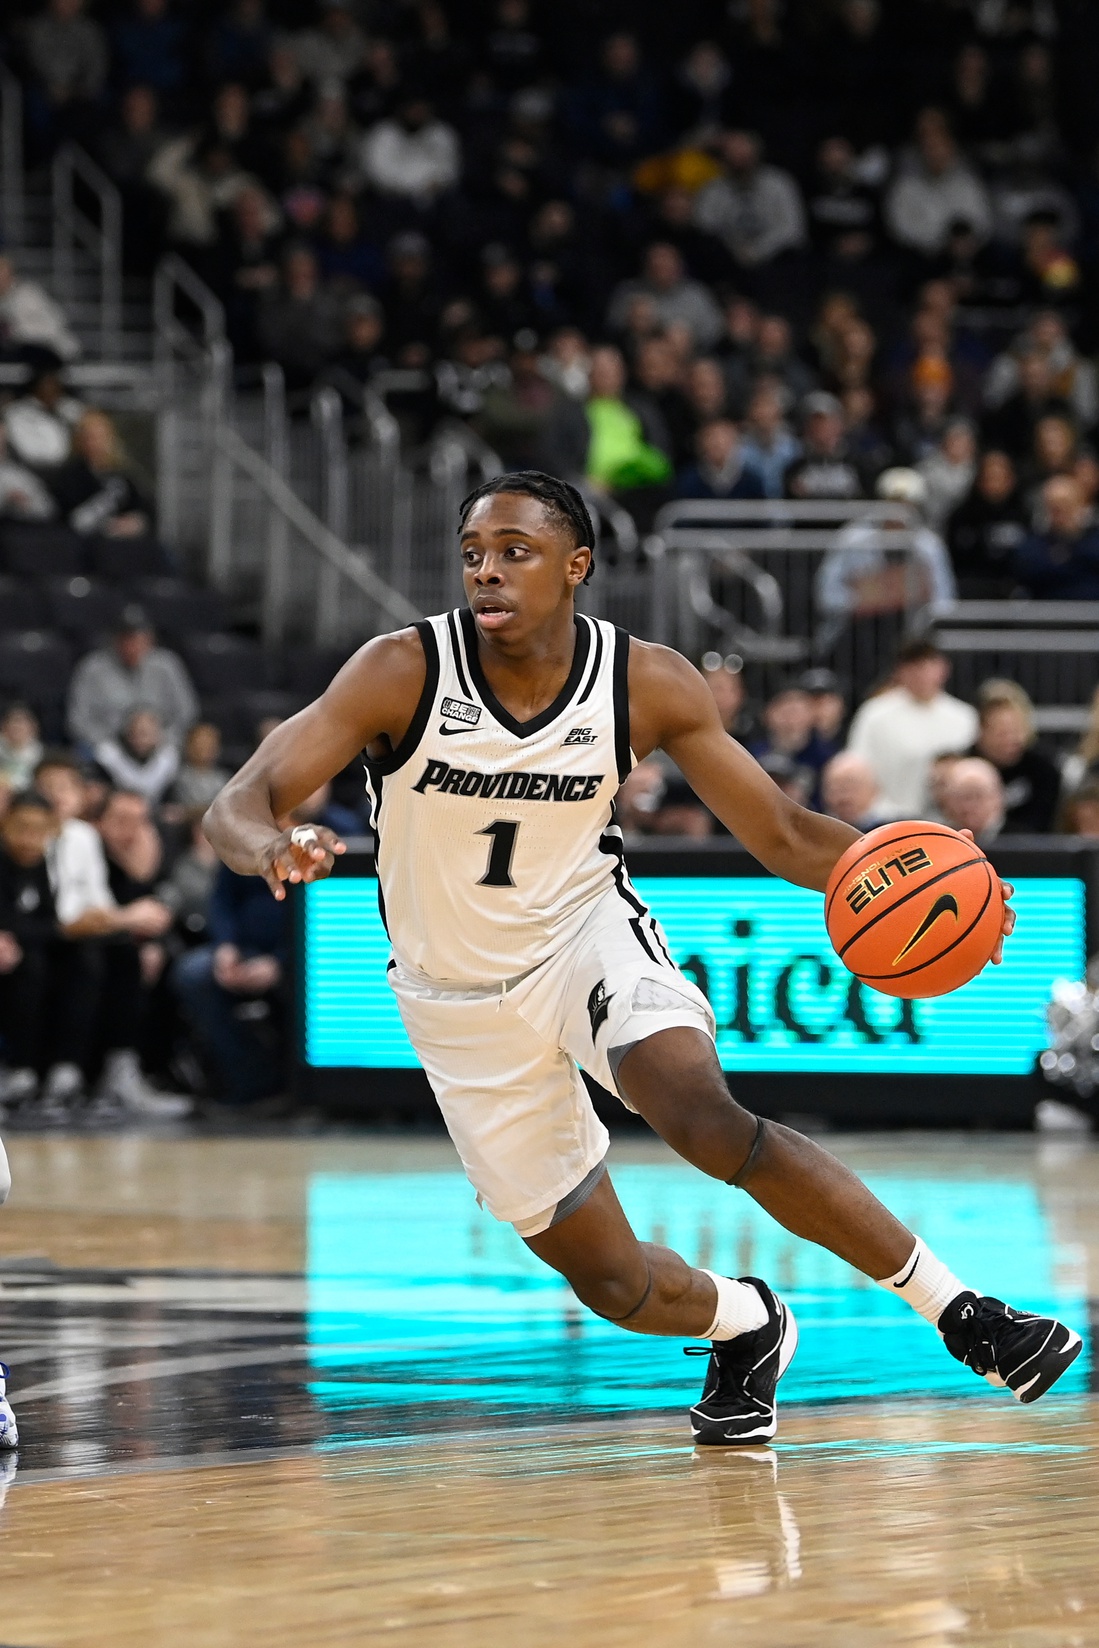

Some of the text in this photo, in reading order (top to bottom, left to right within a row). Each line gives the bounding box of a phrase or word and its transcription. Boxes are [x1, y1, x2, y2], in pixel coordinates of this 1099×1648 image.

[441, 707, 479, 723] CHANGE
[563, 735, 599, 743] EAST
[568, 727, 593, 736] BIG
[410, 758, 606, 802] PROVIDENCE
[473, 818, 522, 888] 1
[845, 847, 934, 915] ELITE
